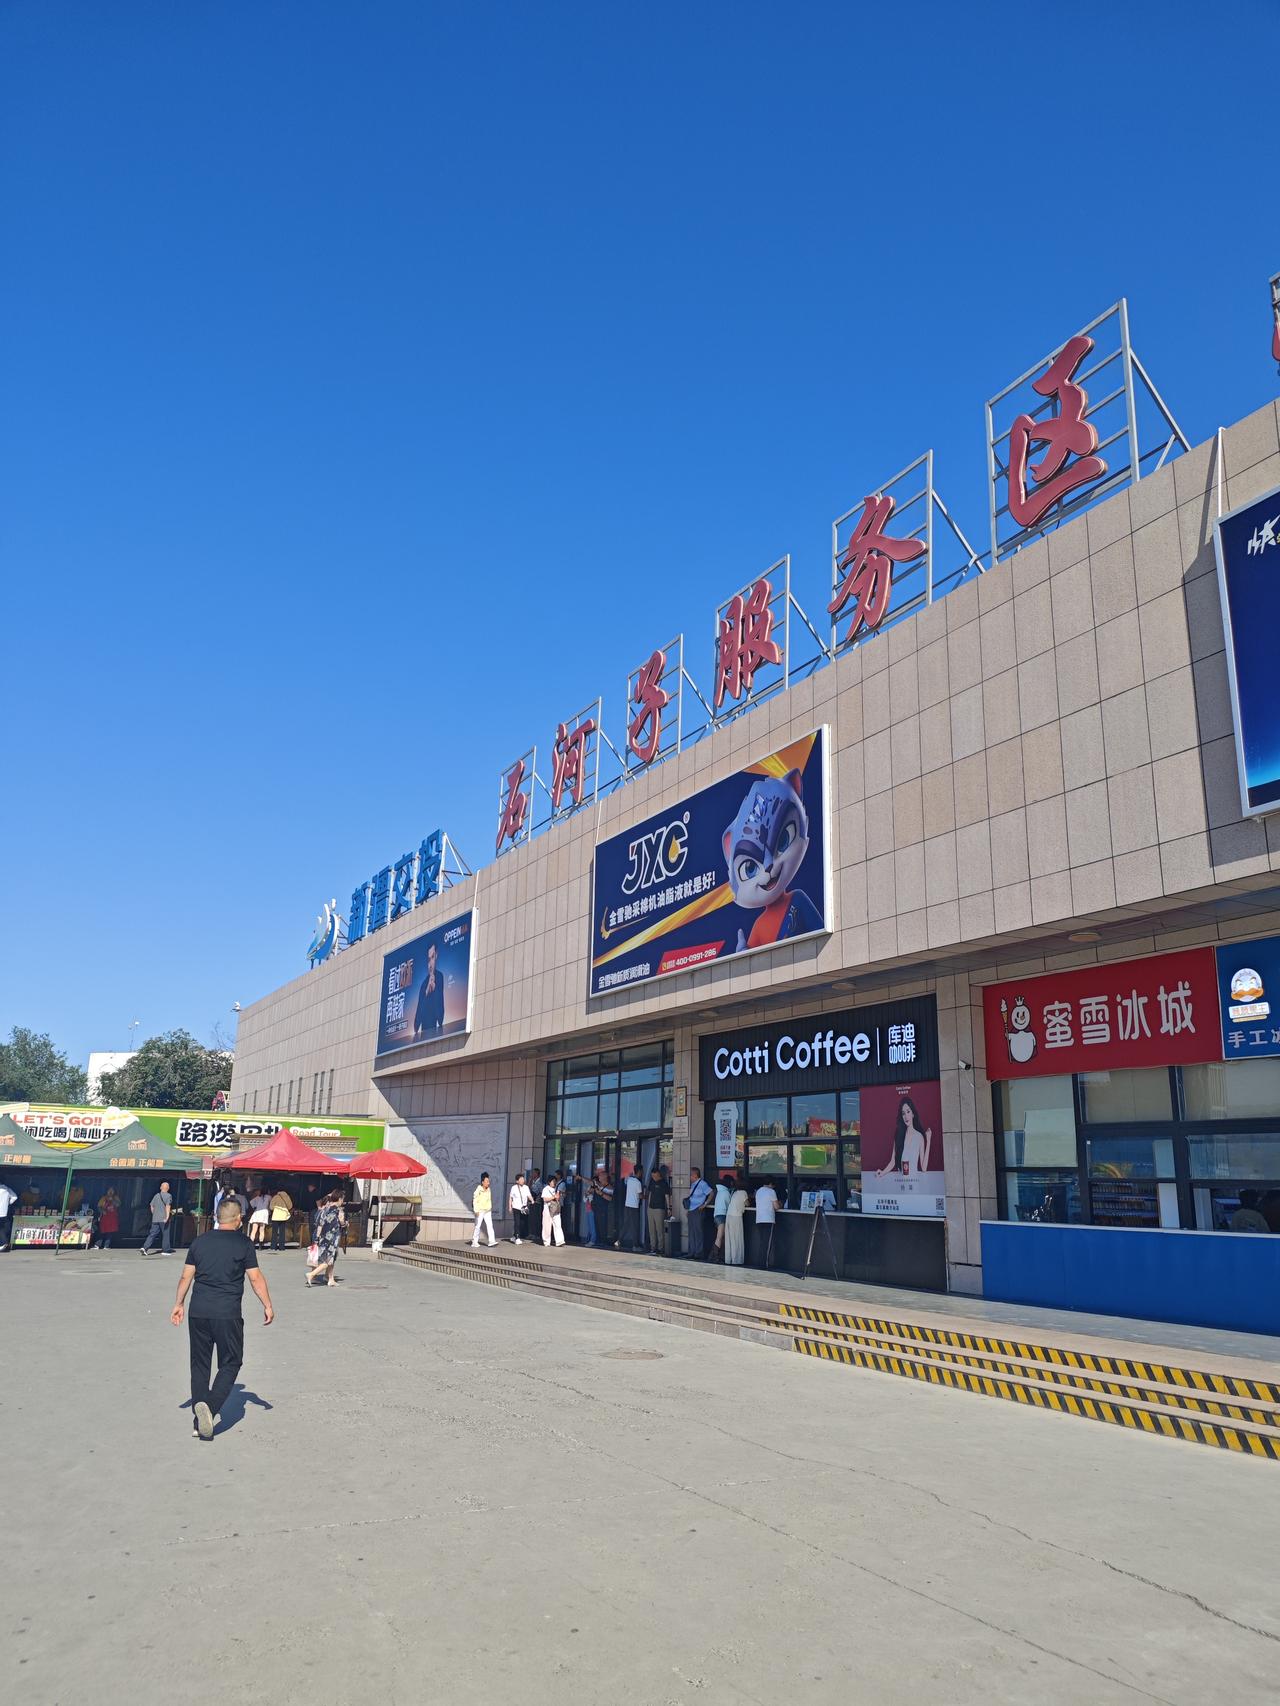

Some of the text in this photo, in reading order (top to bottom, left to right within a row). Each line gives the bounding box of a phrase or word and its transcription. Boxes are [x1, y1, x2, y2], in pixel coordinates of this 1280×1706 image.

[496, 335, 1107, 848] 石河子服务区
[622, 820, 689, 895] JXC
[348, 829, 442, 944] 新疆交投
[888, 1022, 916, 1044] 库迪
[1042, 980, 1196, 1049] 蜜雪冰城
[713, 1030, 870, 1080] Cotti Coffee
[888, 1043, 917, 1065] 咖啡
[13, 1114, 103, 1127] LET'S GO!!
[292, 1128, 316, 1137] Road
